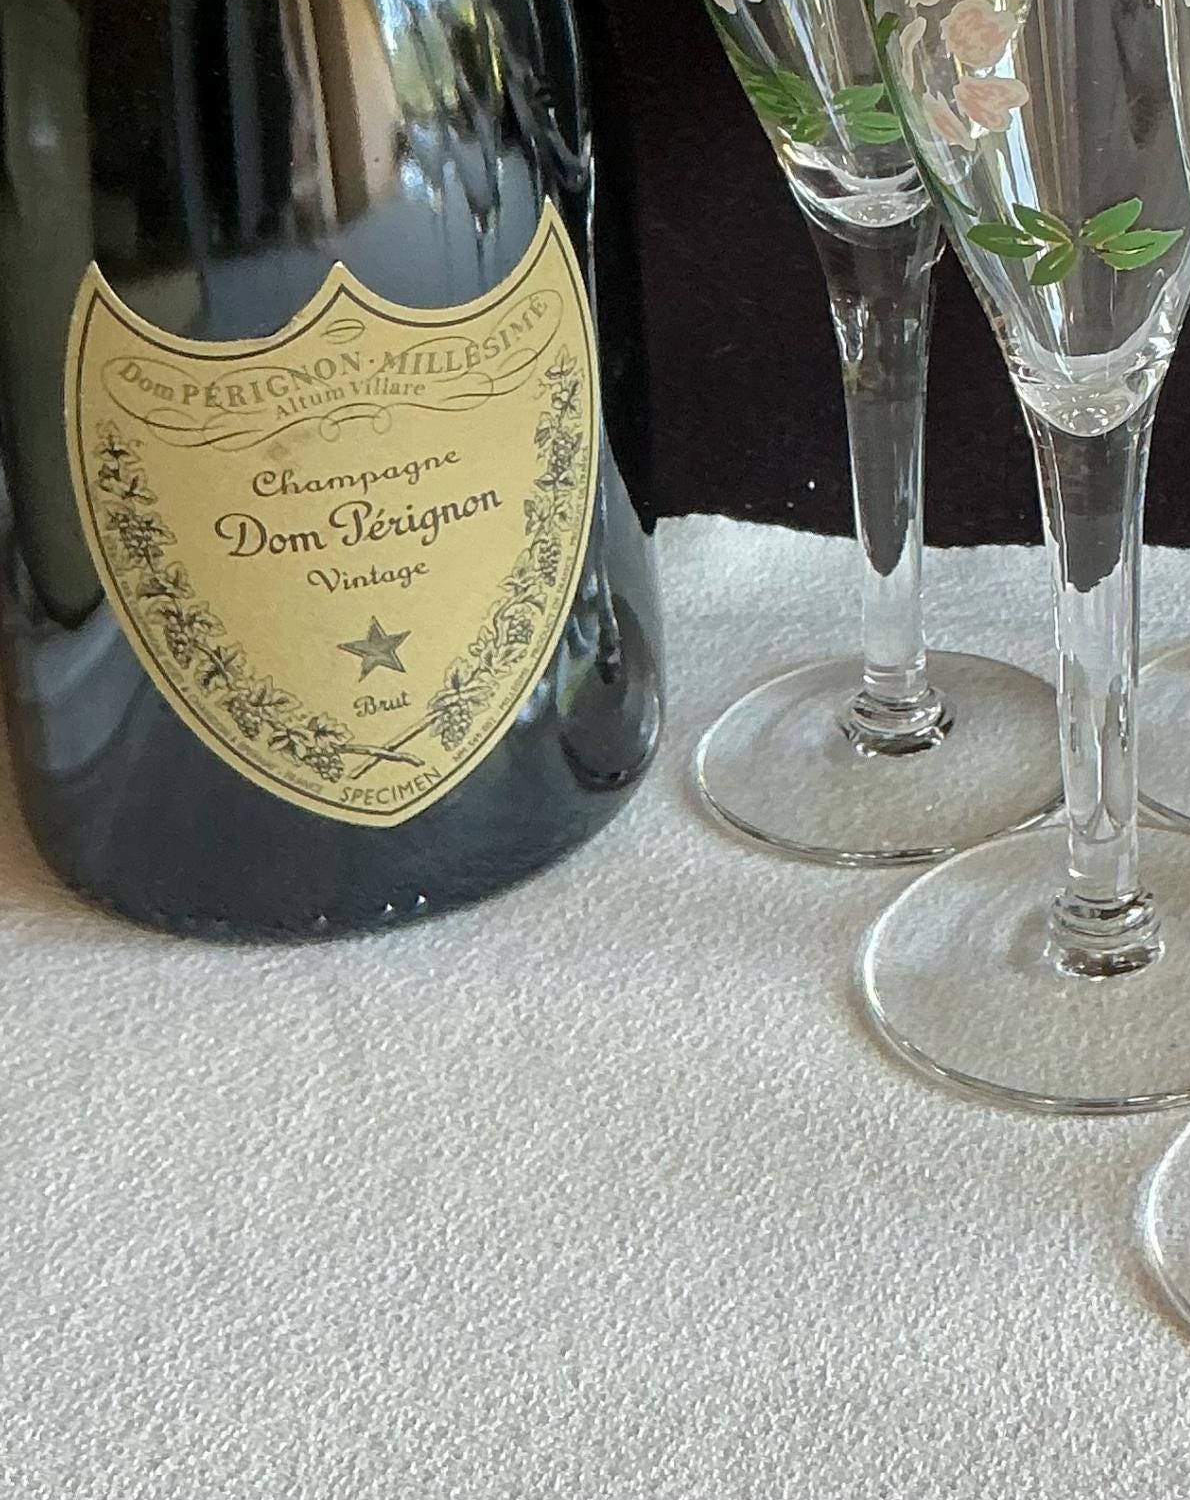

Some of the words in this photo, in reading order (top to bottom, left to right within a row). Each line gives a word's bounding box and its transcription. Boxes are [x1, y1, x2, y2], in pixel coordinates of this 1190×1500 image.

[117, 361, 176, 401] Dom
[177, 350, 361, 409] PÉRIGNON
[275, 386, 346, 421] Altum
[350, 377, 427, 397] Villare
[252, 450, 461, 497] Champagne
[214, 512, 327, 557] Dom
[328, 488, 503, 546] Pérignon
[306, 561, 430, 593] Vintage
[353, 692, 412, 718] Brut
[338, 767, 442, 806] SPECIMEN
